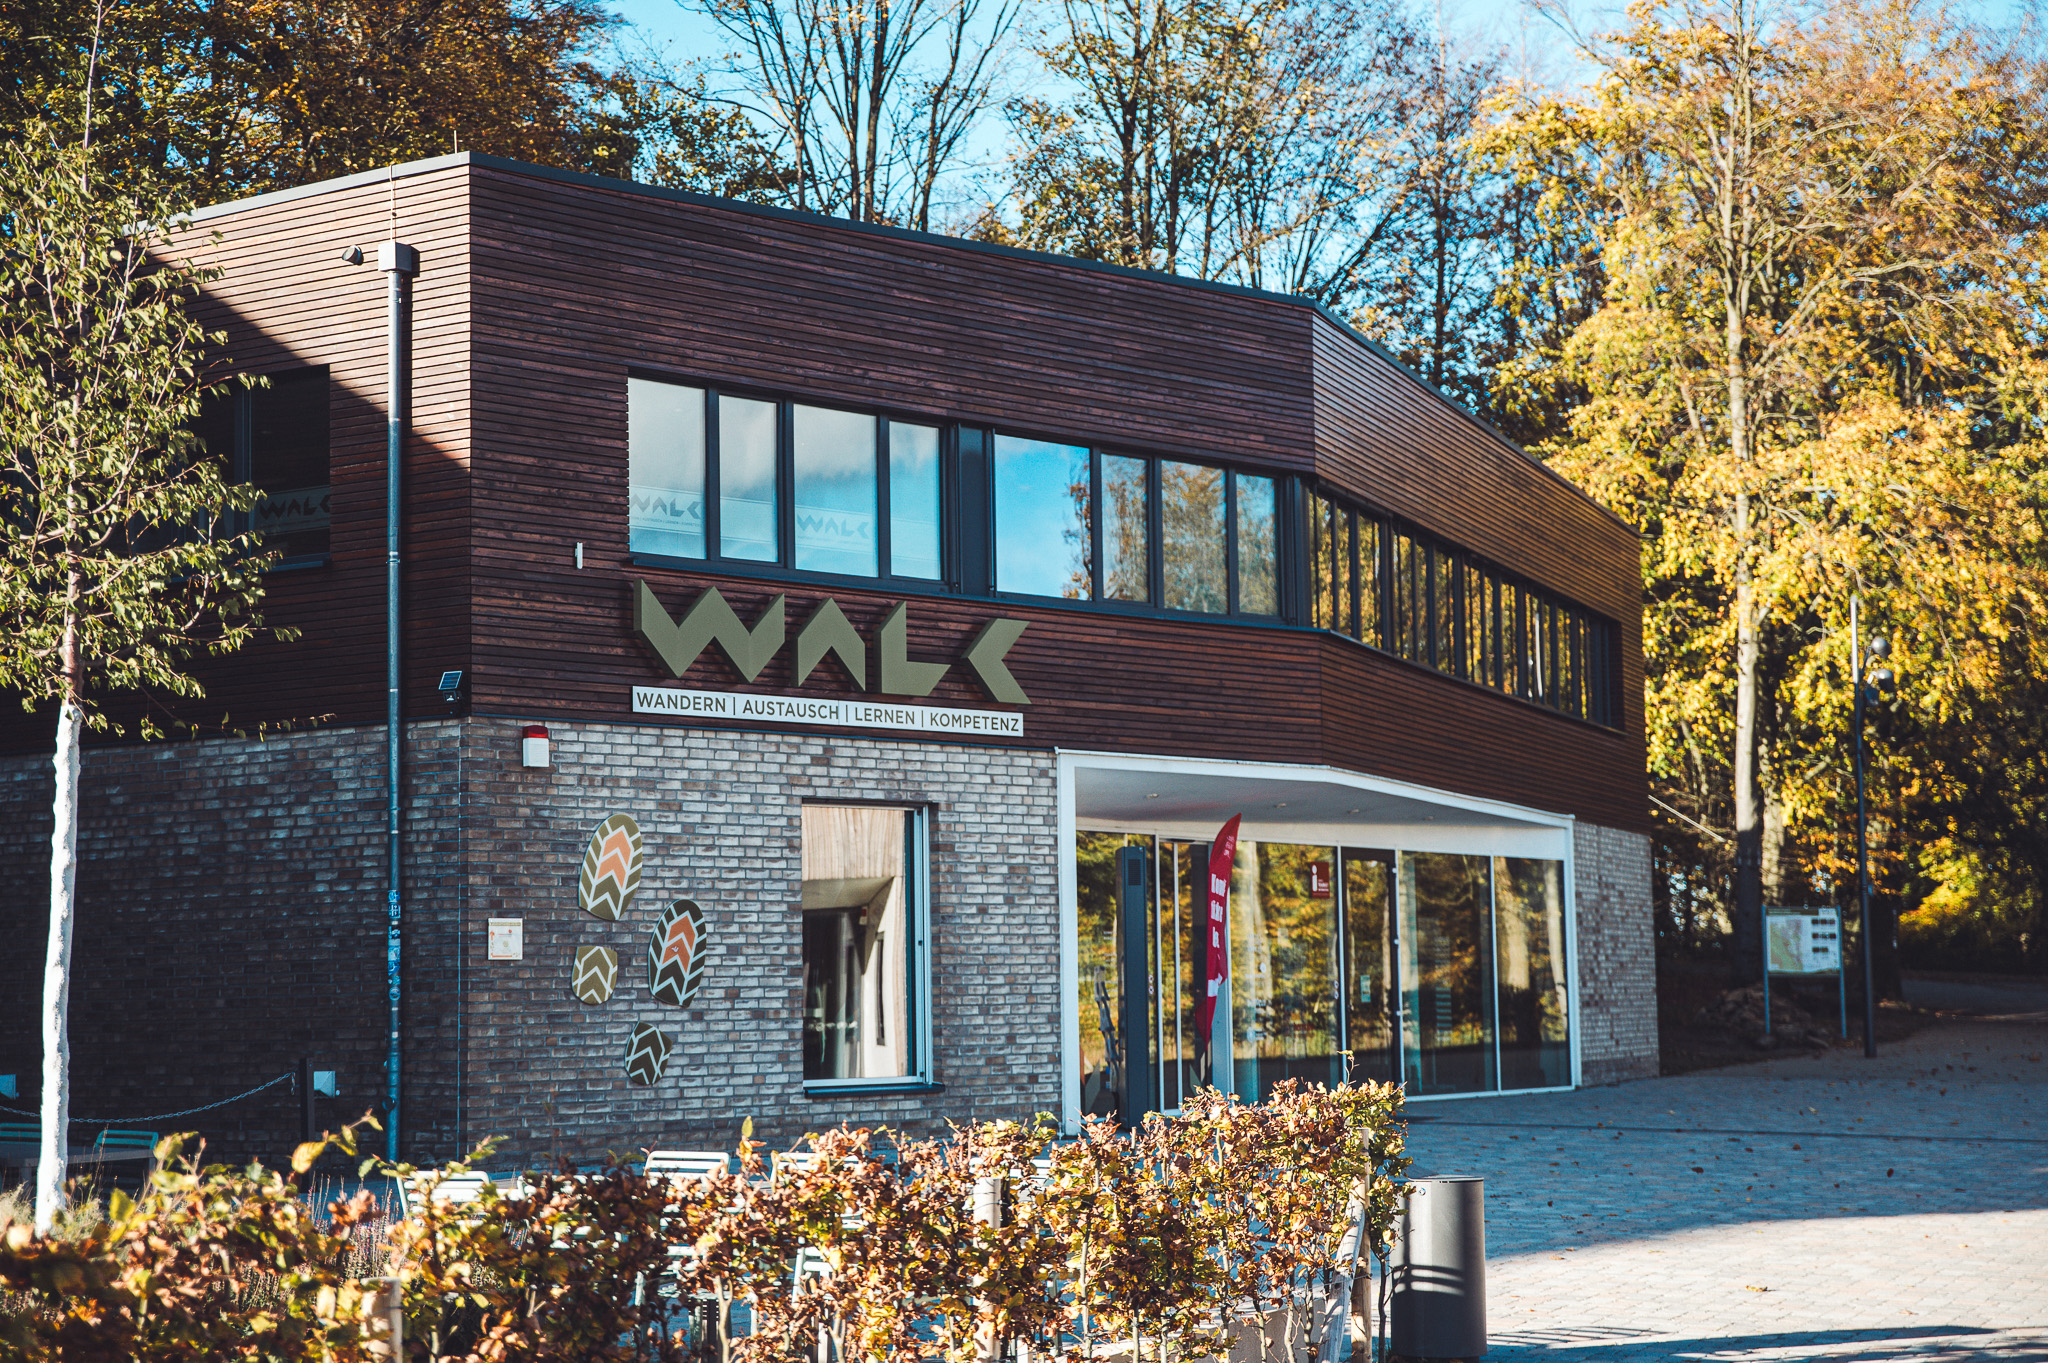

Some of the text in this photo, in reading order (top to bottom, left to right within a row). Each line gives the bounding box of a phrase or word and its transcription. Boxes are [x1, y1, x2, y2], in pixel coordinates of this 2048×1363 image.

[796, 513, 870, 540] WALK
[633, 578, 1032, 705] WALK
[636, 691, 1020, 732] WANDERN AUSTAUSCH LERNEN KOMPETENZ
